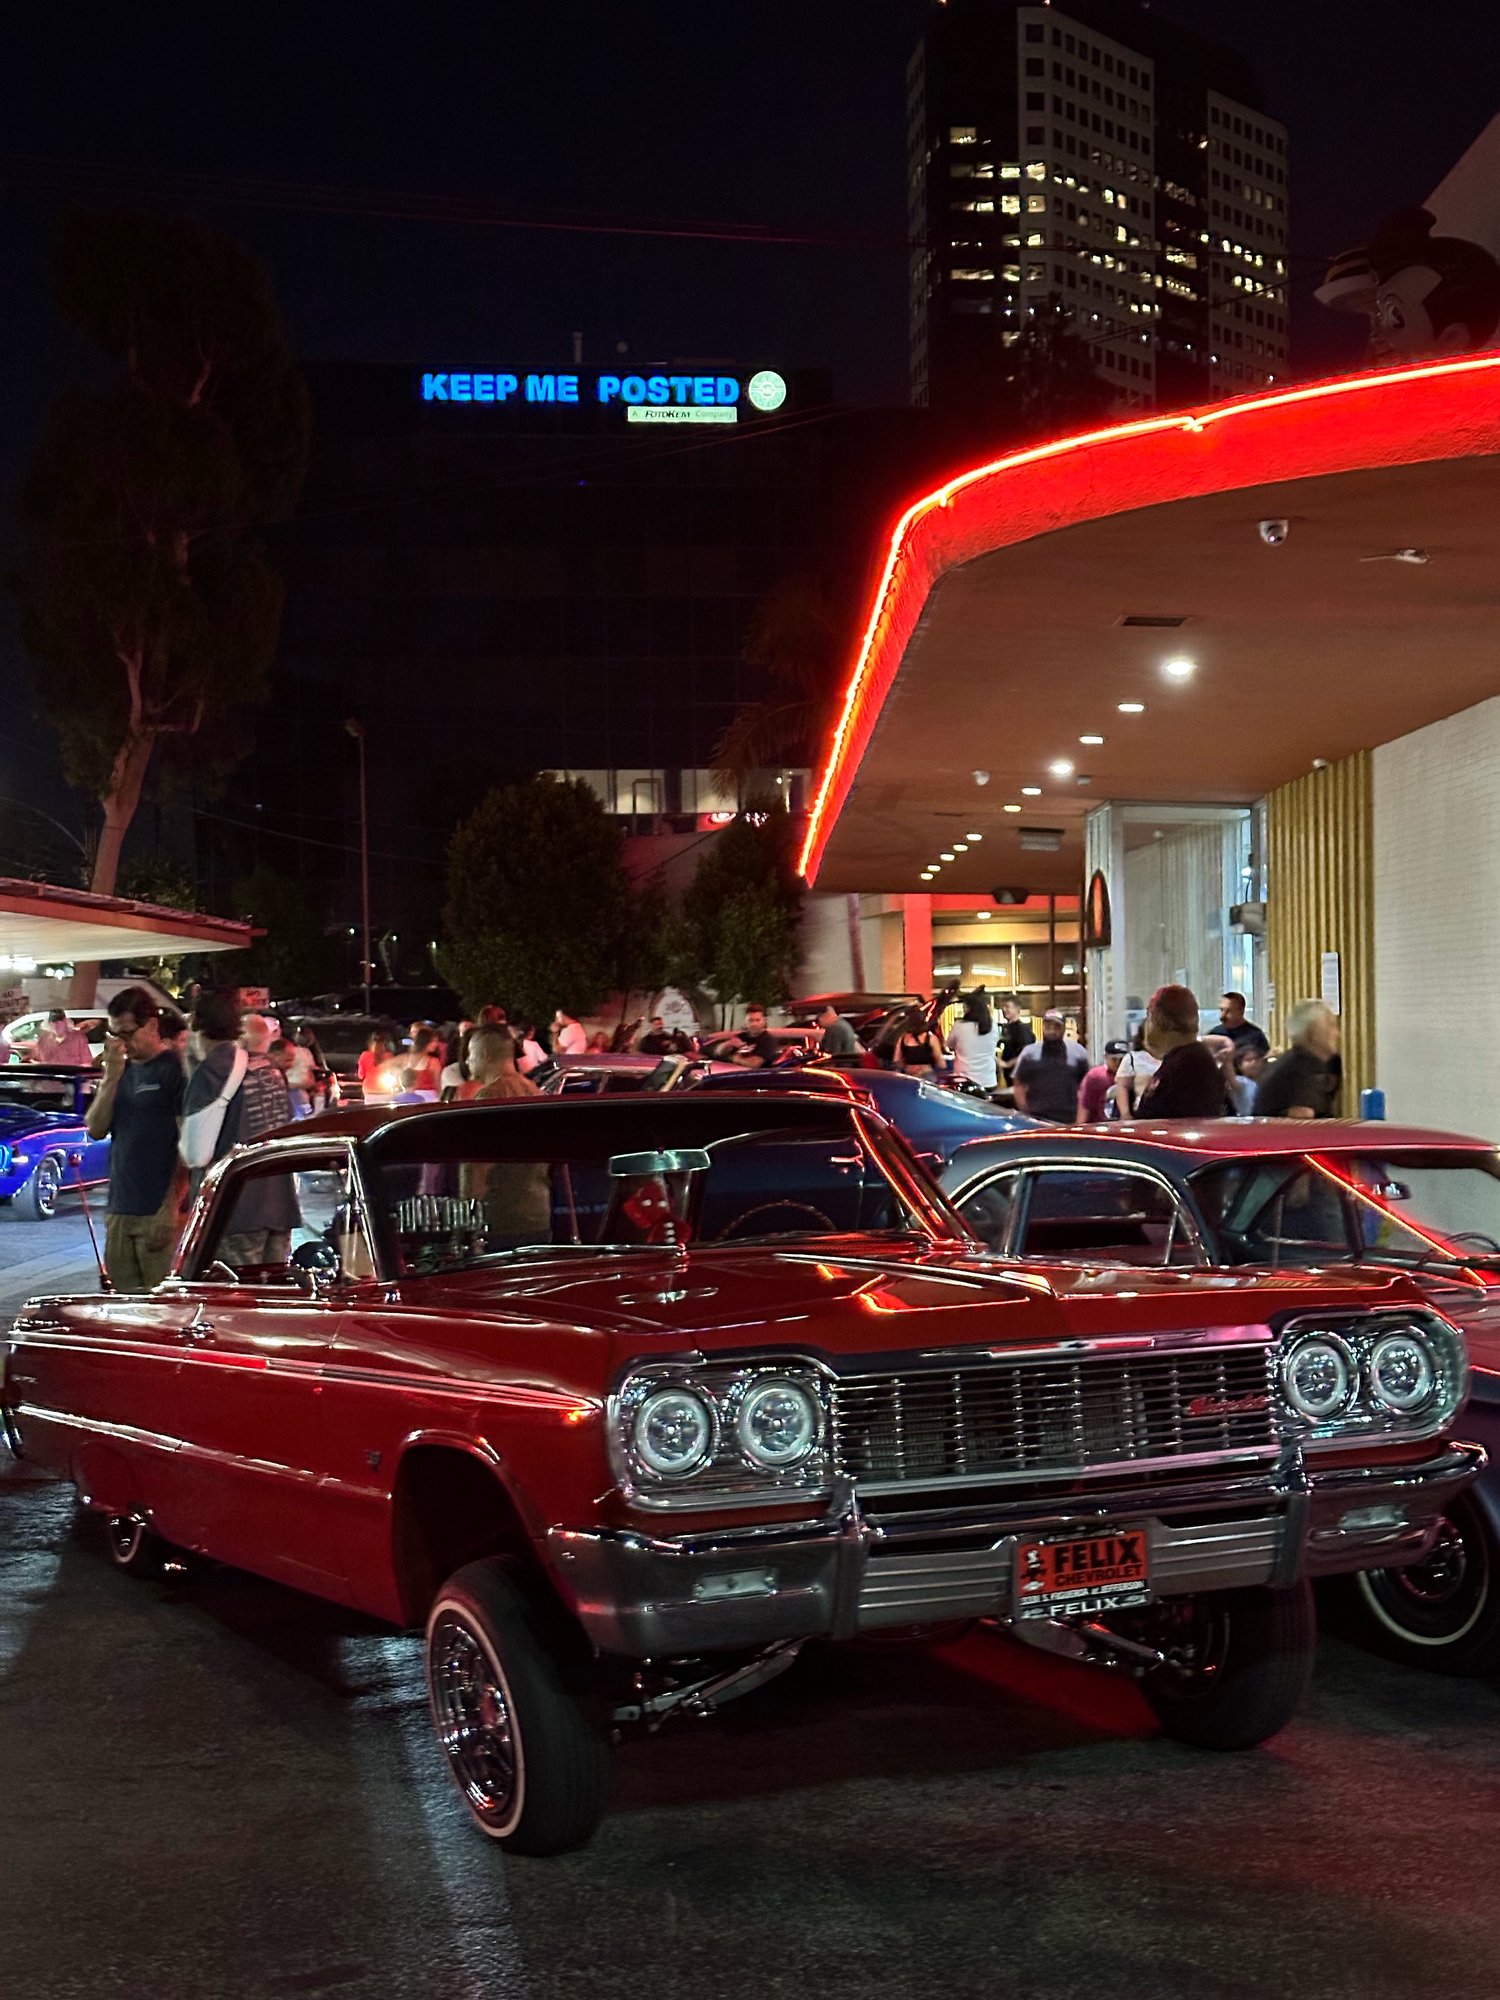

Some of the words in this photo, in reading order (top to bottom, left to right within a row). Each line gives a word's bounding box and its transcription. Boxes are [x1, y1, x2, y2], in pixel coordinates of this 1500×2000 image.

[422, 373, 518, 402] KEEP
[526, 374, 579, 403] ME
[599, 376, 740, 404] POSTED
[695, 410, 732, 419] Company
[1054, 1536, 1140, 1574] FELIX
[1055, 1565, 1142, 1587] CHEVROLET
[1050, 1596, 1119, 1617] FELIX
